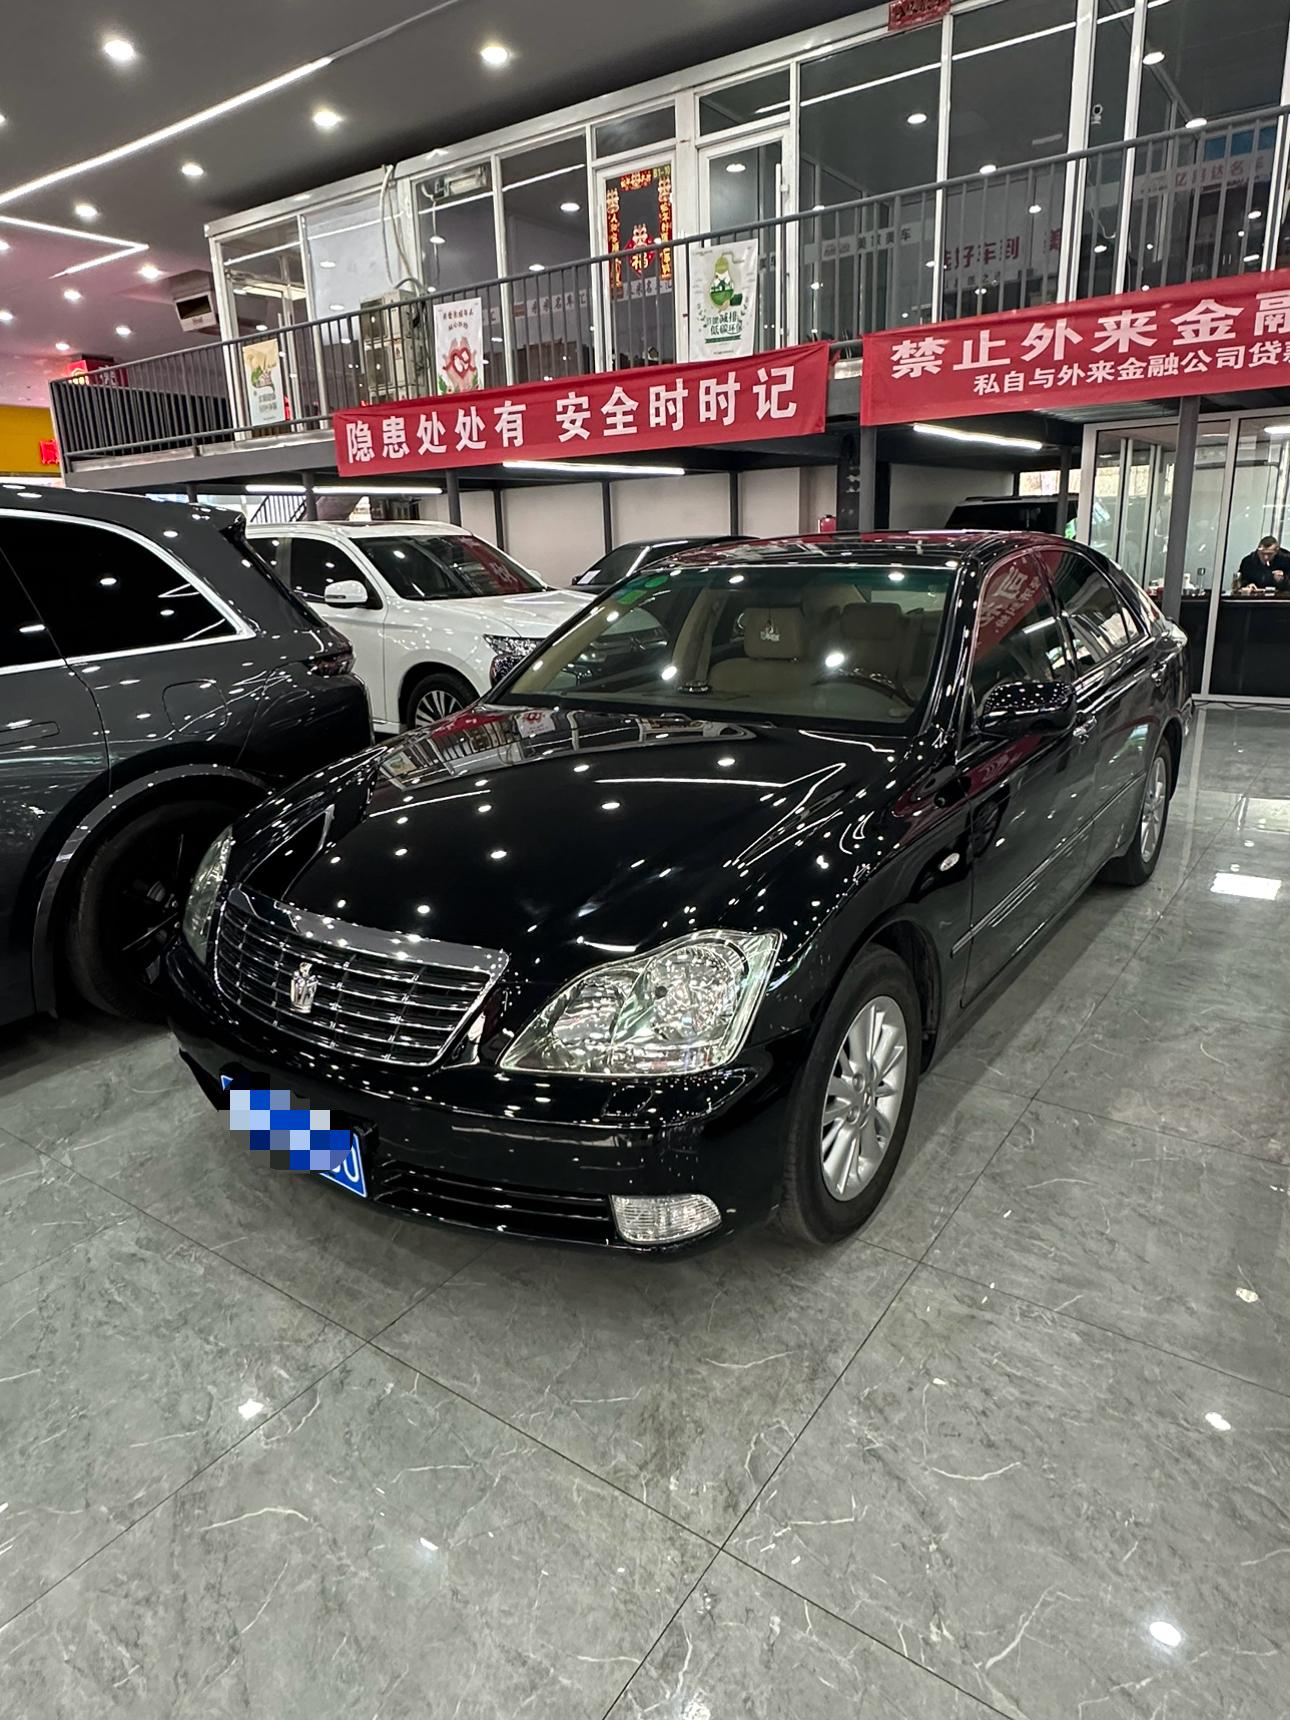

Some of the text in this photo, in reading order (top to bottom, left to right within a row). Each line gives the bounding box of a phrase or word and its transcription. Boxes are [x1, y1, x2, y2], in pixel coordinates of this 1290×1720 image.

[973, 340, 1290, 396] 私自与外来金融公司贷
[345, 365, 799, 464] 隐患处处有 安全时时记
